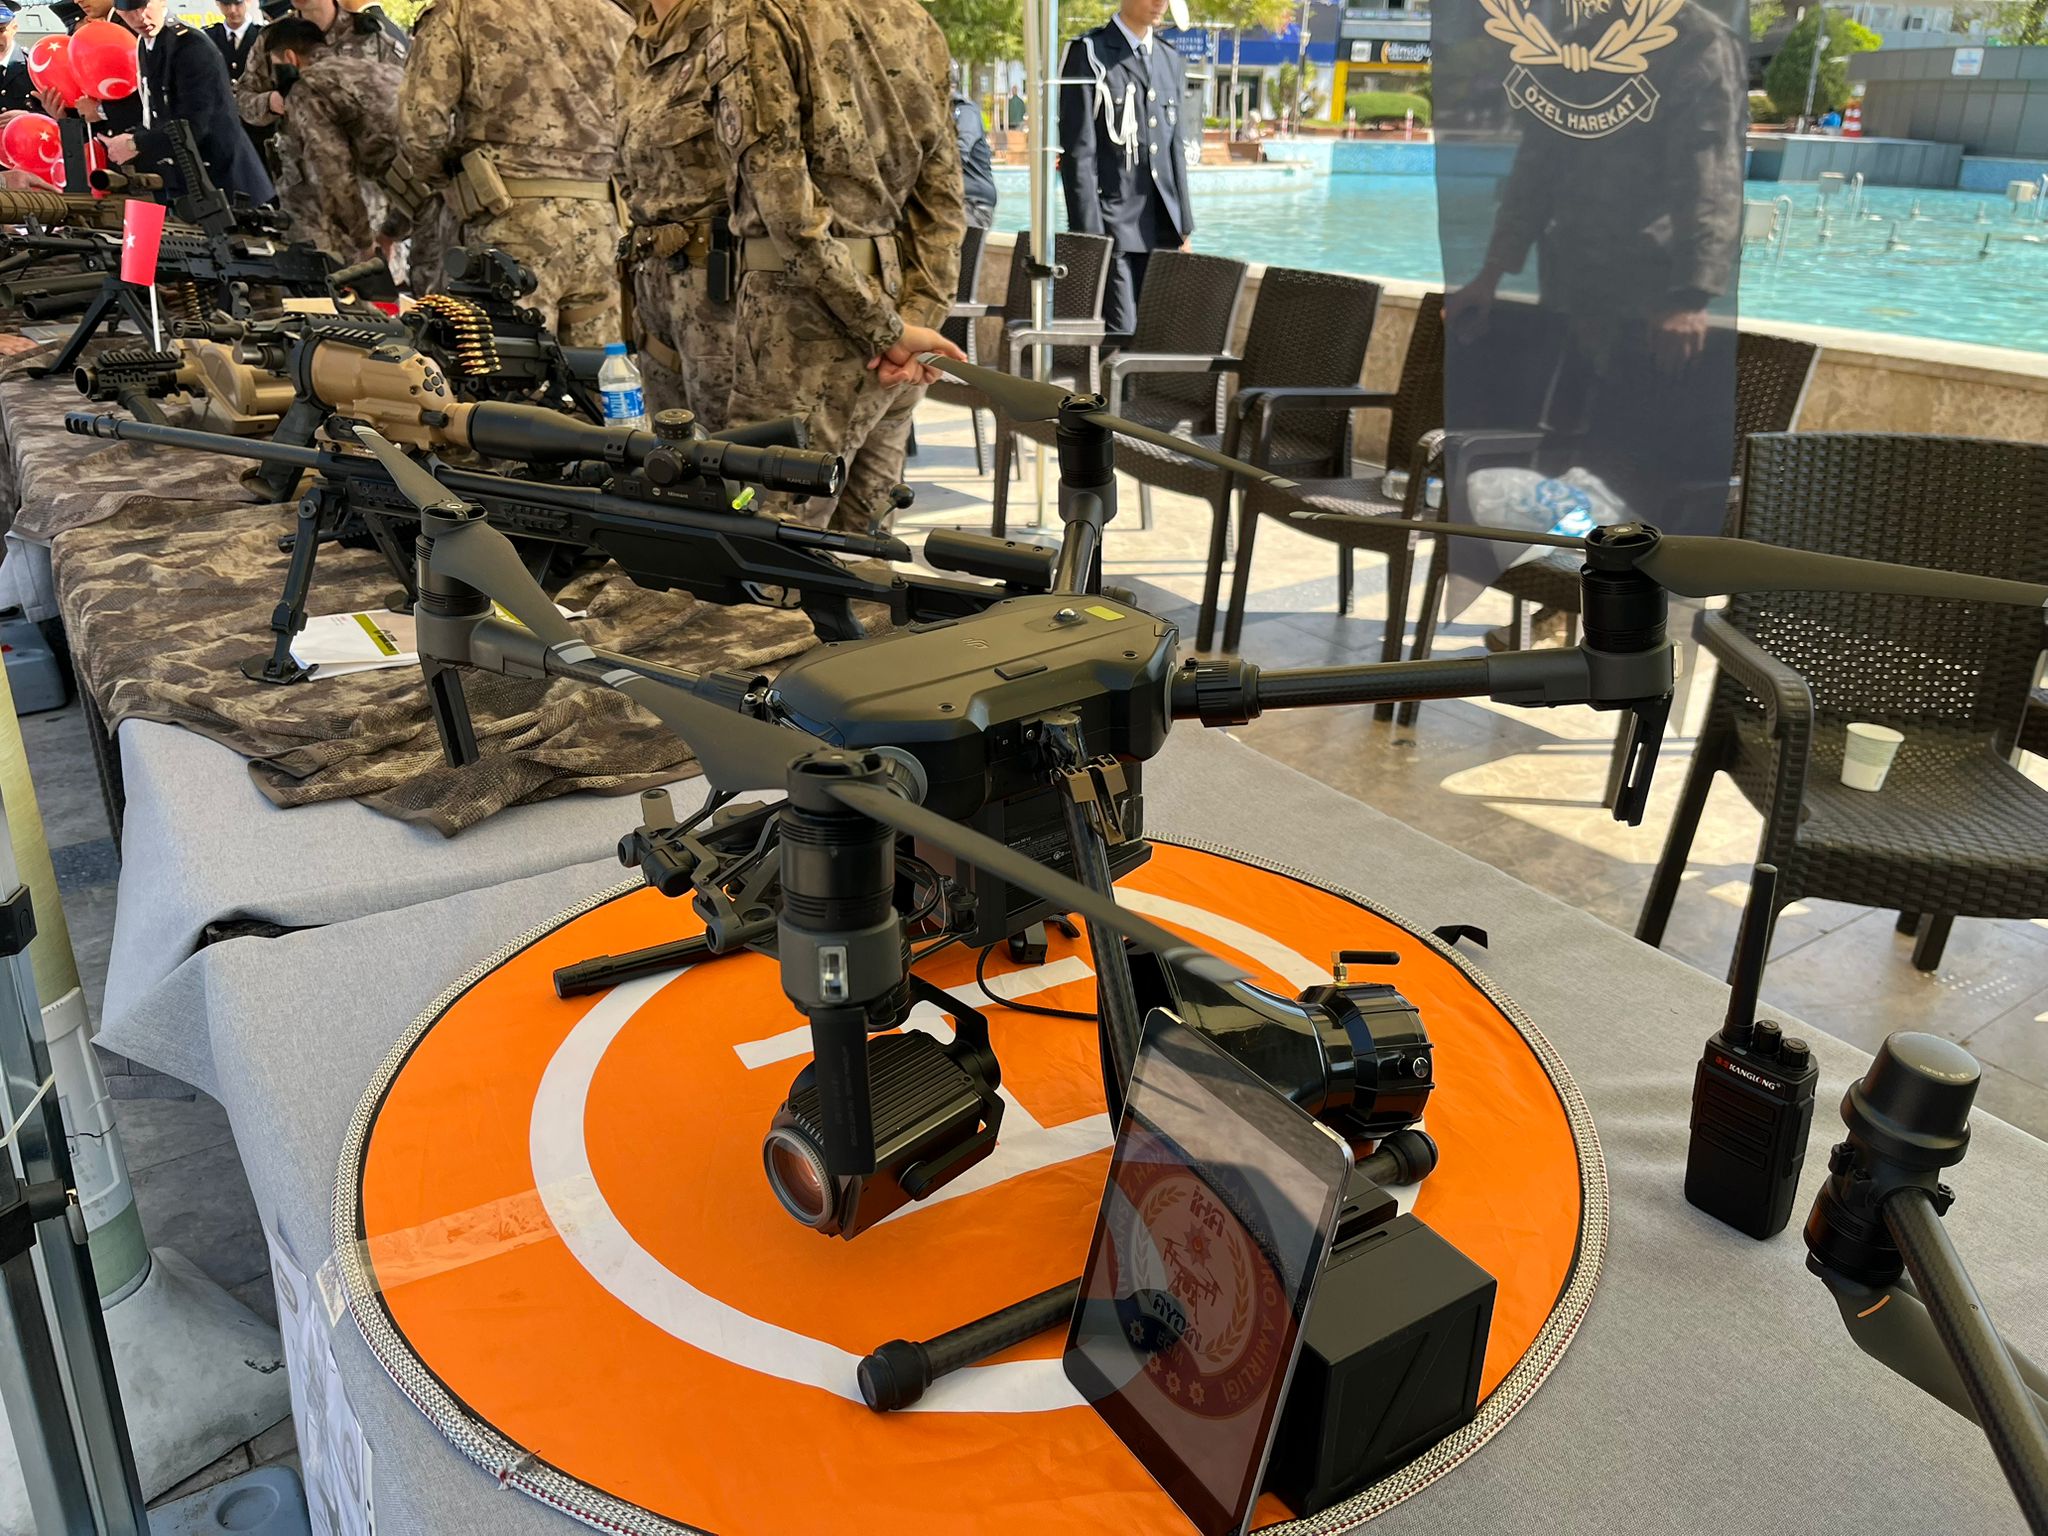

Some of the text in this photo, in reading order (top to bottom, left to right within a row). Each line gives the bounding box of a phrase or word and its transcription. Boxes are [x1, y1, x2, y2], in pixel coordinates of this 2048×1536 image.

[1524, 85, 1636, 131] ÖZEL HAREKAT
[1728, 1063, 1776, 1091] KANGLONG
[1190, 1184, 1225, 1238] İHA
